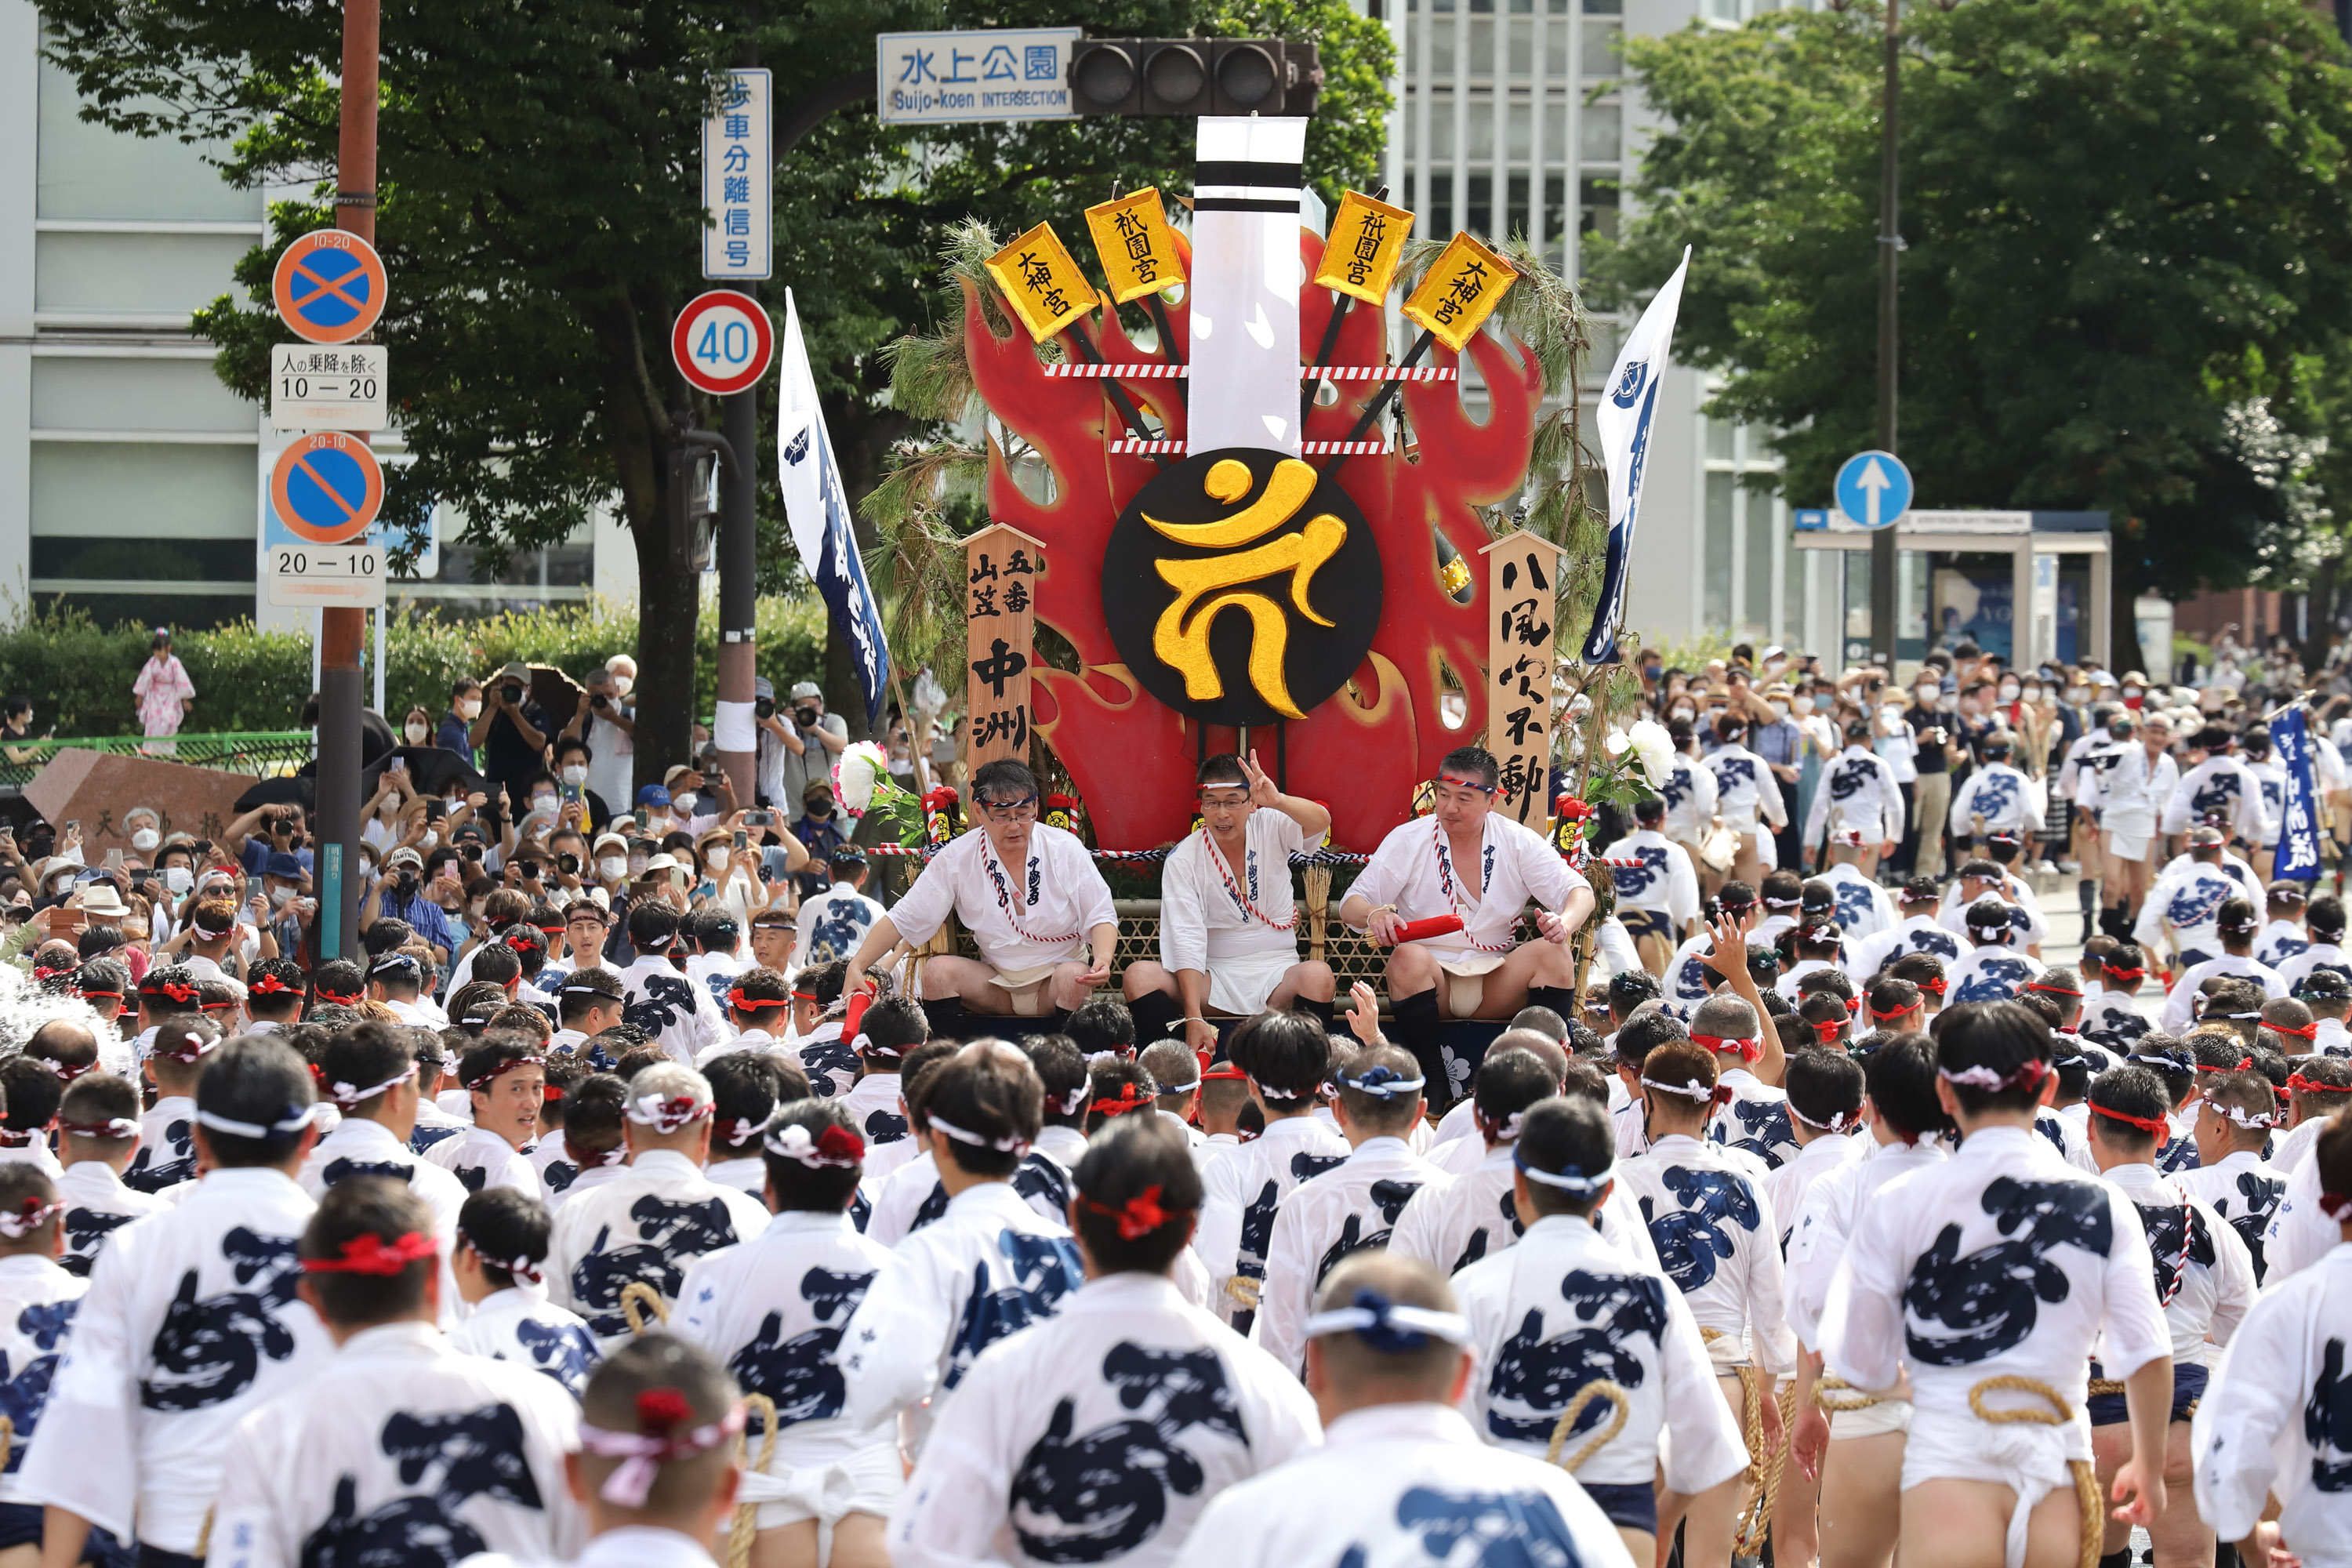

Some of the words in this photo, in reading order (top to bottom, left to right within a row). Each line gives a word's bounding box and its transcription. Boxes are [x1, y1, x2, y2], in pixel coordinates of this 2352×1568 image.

[900, 45, 1057, 84] 水上公園
[894, 89, 975, 113] Suijo-koen
[982, 89, 1067, 107] INTERSECTION
[724, 82, 751, 268] 歩車分離信号
[314, 234, 350, 249] 10-20
[1113, 208, 1159, 285] 祇園宮
[1346, 211, 1387, 286] 祇園宮
[1018, 252, 1073, 318] 大神宮
[1433, 260, 1488, 326] 大神宮
[281, 353, 376, 374] 人の乗降を除く
[696, 321, 749, 365] 40
[309, 436, 347, 449] 20-10
[970, 554, 1001, 619] 山笠
[1002, 550, 1034, 614] 五番
[971, 638, 1028, 789] 中洲
[1498, 553, 1552, 828] 八風吹不動
